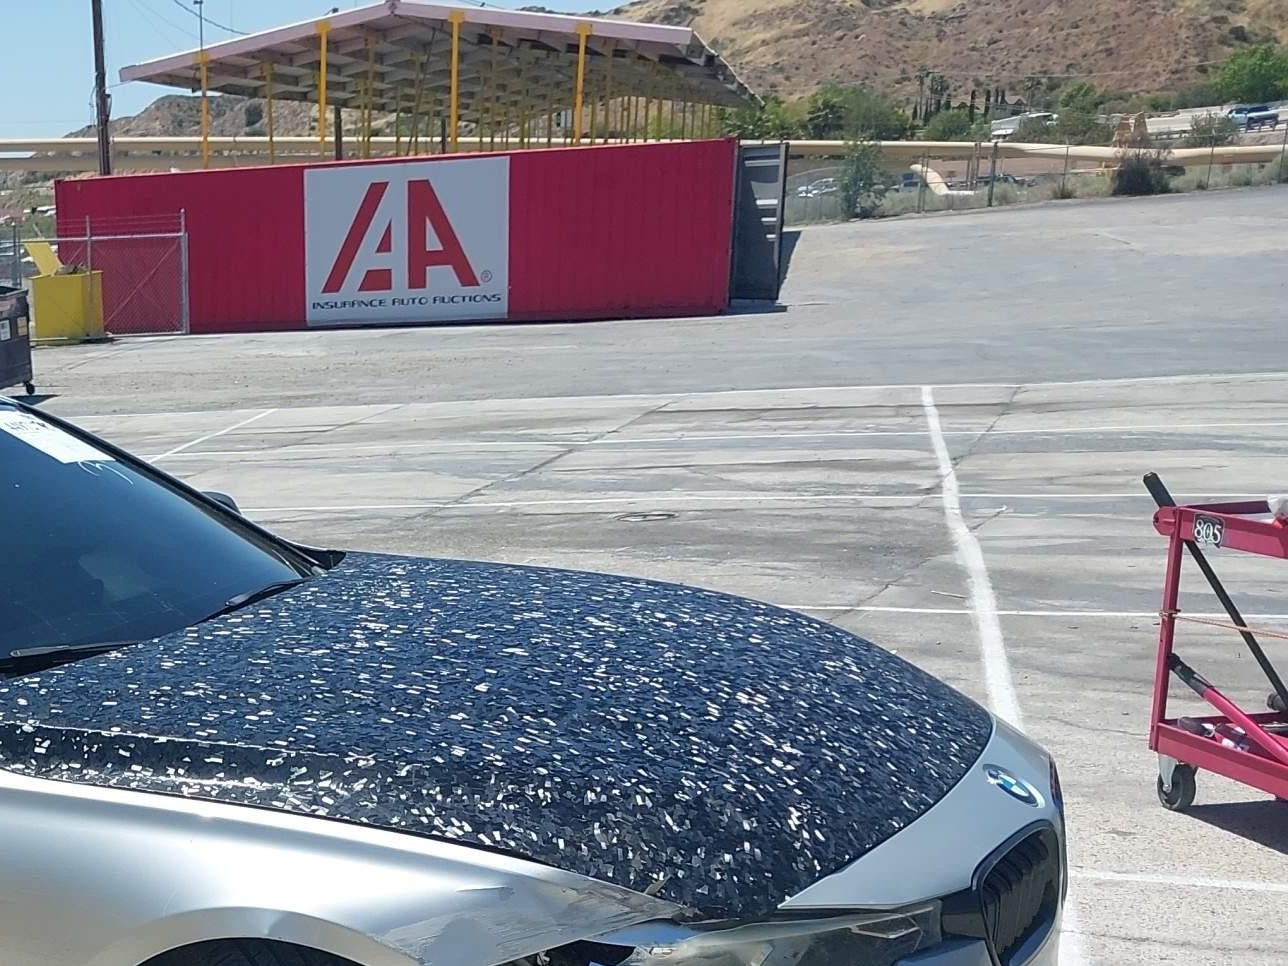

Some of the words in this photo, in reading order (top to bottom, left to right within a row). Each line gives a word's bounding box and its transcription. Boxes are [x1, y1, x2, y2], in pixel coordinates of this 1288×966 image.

[312, 300, 387, 310] INSURANCE
[392, 297, 428, 307] AUTO
[432, 294, 502, 305] AUCTIONS
[1194, 519, 1223, 544] 805
